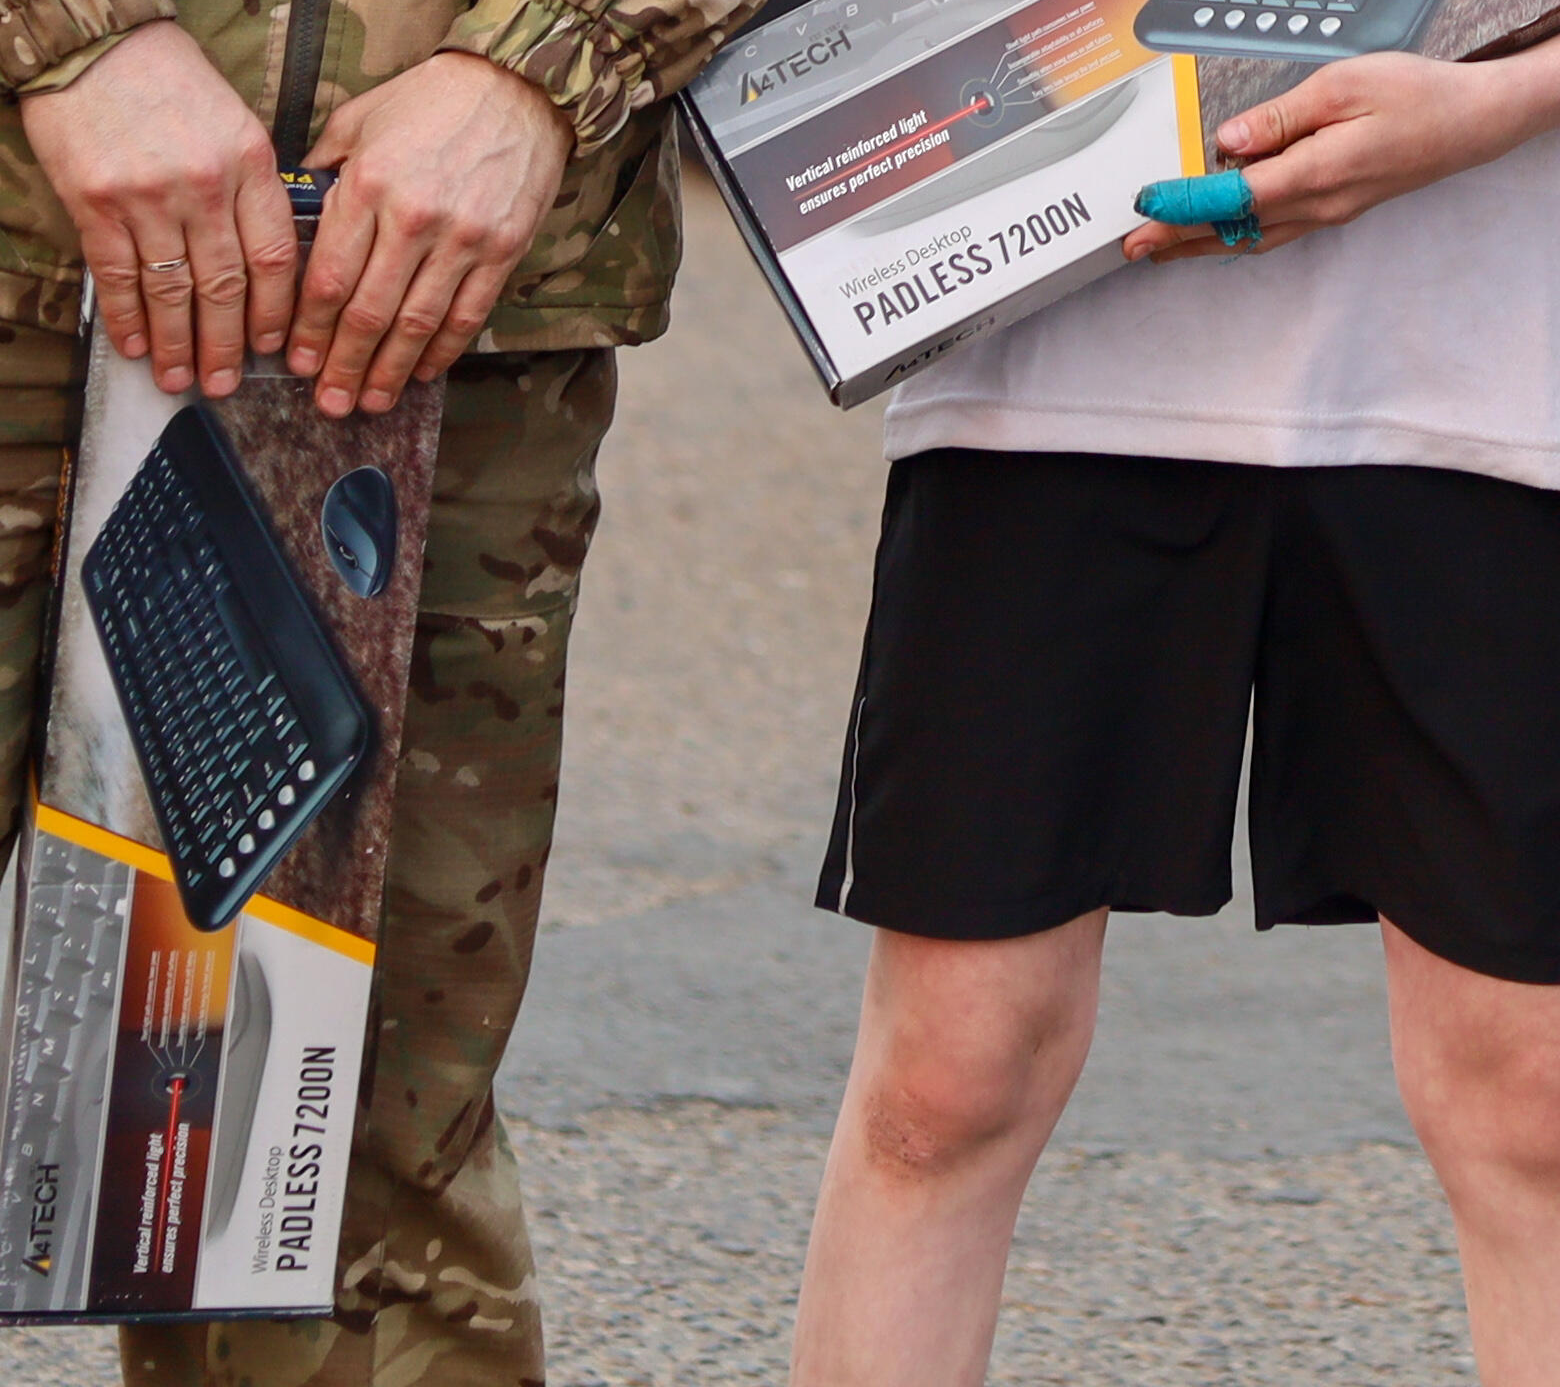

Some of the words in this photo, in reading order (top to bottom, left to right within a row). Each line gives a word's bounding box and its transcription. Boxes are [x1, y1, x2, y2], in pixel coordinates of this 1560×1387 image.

[740, 30, 852, 106] A4TECH
[785, 156, 834, 192] Vertical
[835, 123, 899, 167] reinforced
[900, 109, 928, 136] light
[799, 181, 847, 215] ensures
[848, 156, 893, 193] perfect
[894, 128, 950, 169] precision
[839, 257, 906, 300] Wireless
[904, 225, 973, 267] Desktop
[852, 242, 993, 336] PADLESS
[988, 192, 1092, 265] 7200N
[293, 1046, 336, 1138] 7200N
[146, 1132, 164, 1163] light
[171, 1123, 190, 1179] precision
[260, 1146, 285, 1210] Desktop
[21, 1163, 60, 1278] A4TECH
[142, 1160, 160, 1226] reinforced
[167, 1176, 184, 1226] perfect
[276, 1144, 323, 1273] PADLESS
[133, 1226, 151, 1274] Vertical
[161, 1225, 178, 1274] ensures
[252, 1212, 273, 1275] Wireless
